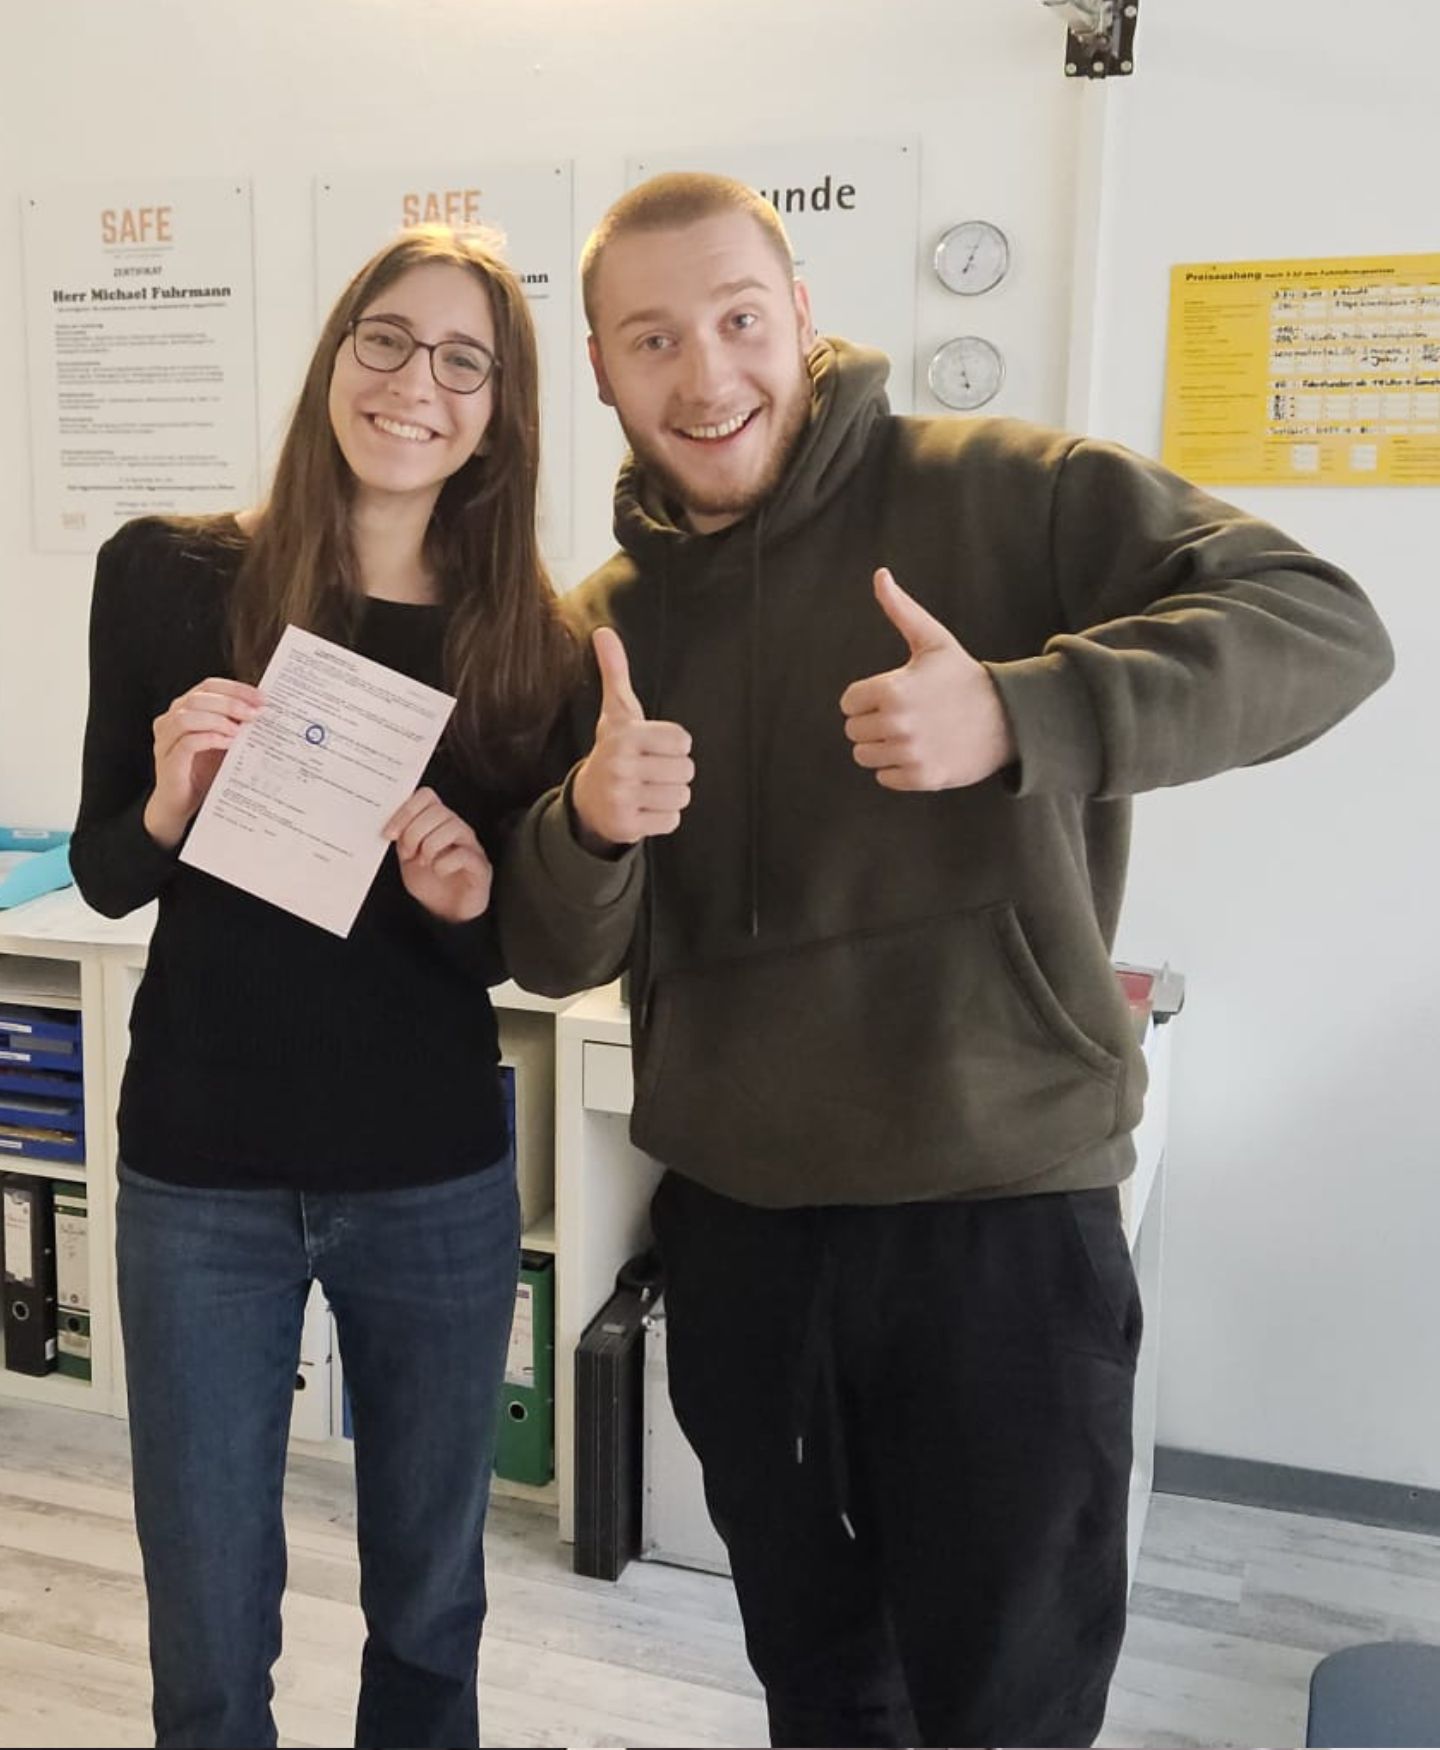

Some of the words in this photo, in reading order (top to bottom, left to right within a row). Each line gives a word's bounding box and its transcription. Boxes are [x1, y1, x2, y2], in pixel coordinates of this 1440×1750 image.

[403, 189, 482, 228] SAFE
[761, 175, 856, 213] unde
[101, 206, 173, 245] SAFE
[53, 289, 87, 303] Herr
[91, 287, 148, 301] Michael
[151, 286, 231, 299] Fuhrmann
